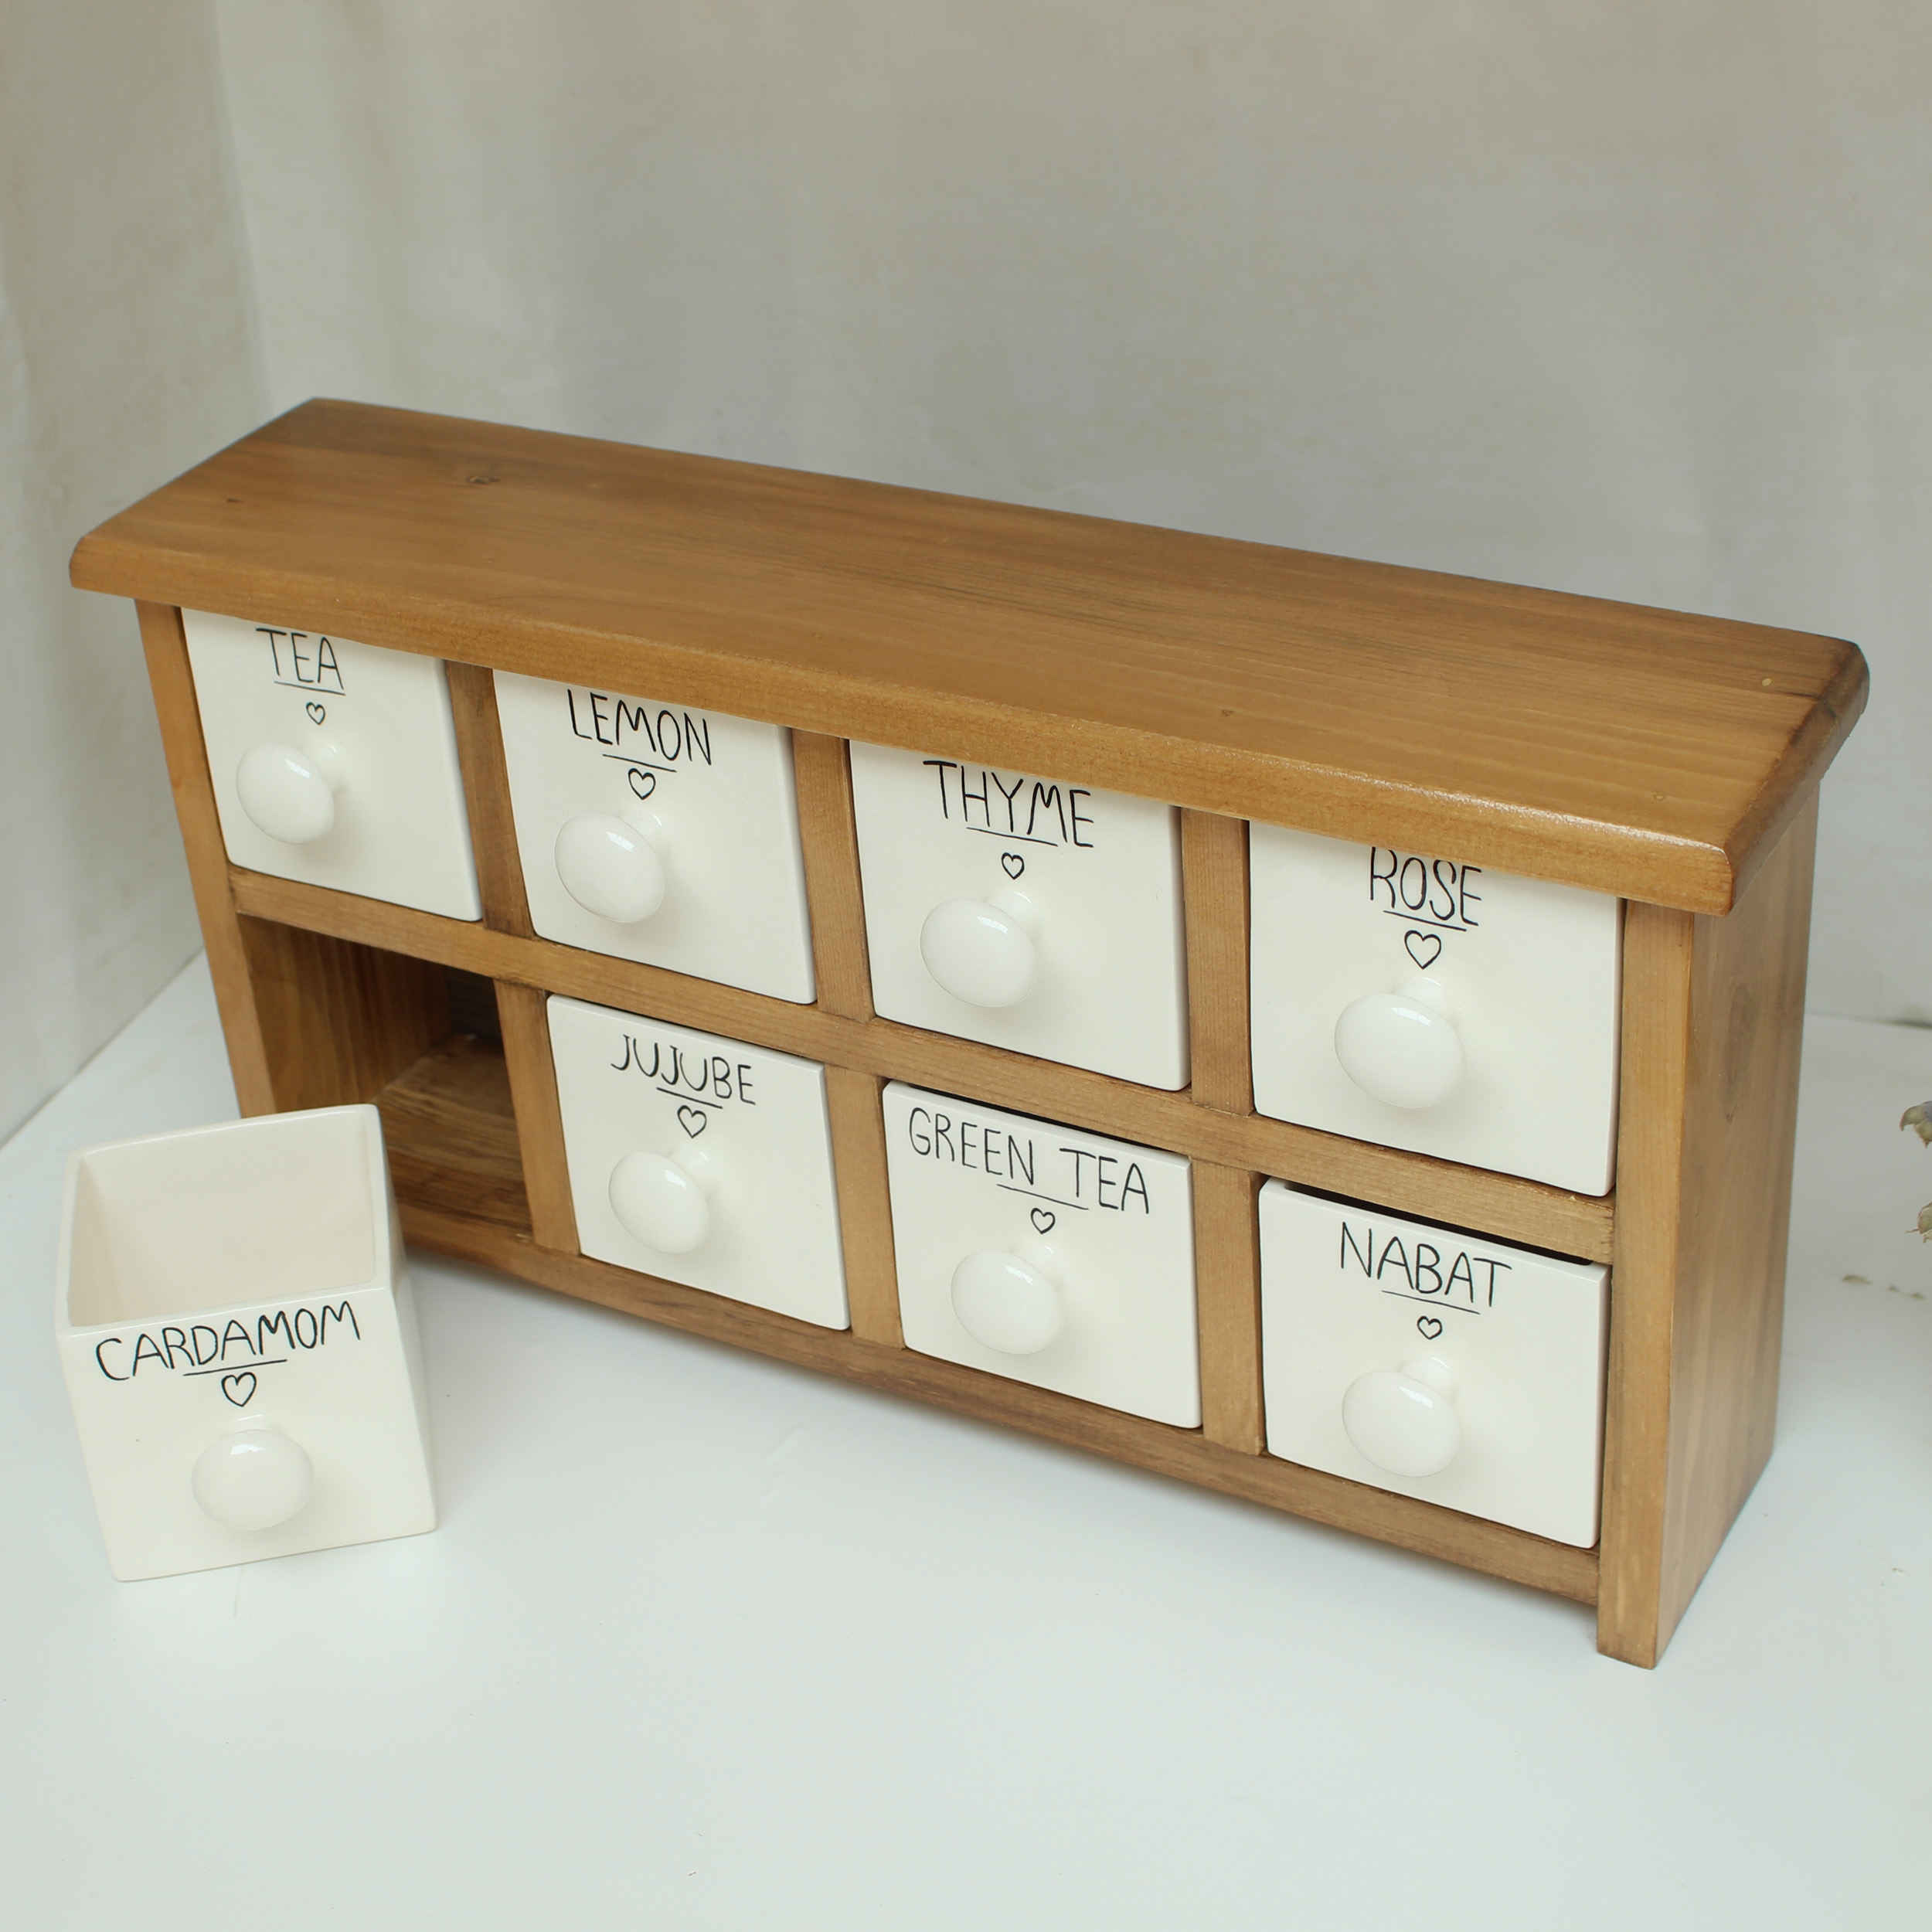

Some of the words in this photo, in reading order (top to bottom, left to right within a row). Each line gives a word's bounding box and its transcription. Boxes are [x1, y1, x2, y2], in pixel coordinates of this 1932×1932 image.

[256, 627, 345, 690] TEA
[566, 688, 712, 766] LEMON
[923, 760, 1095, 848] THYME
[1370, 846, 1482, 927] ROSE
[611, 1034, 757, 1105] JUJUBE
[909, 1107, 1035, 1185] GREEN
[1060, 1148, 1150, 1214] TEA
[1341, 1221, 1513, 1308] NABAT
[96, 1301, 360, 1381] CARDAMOM
